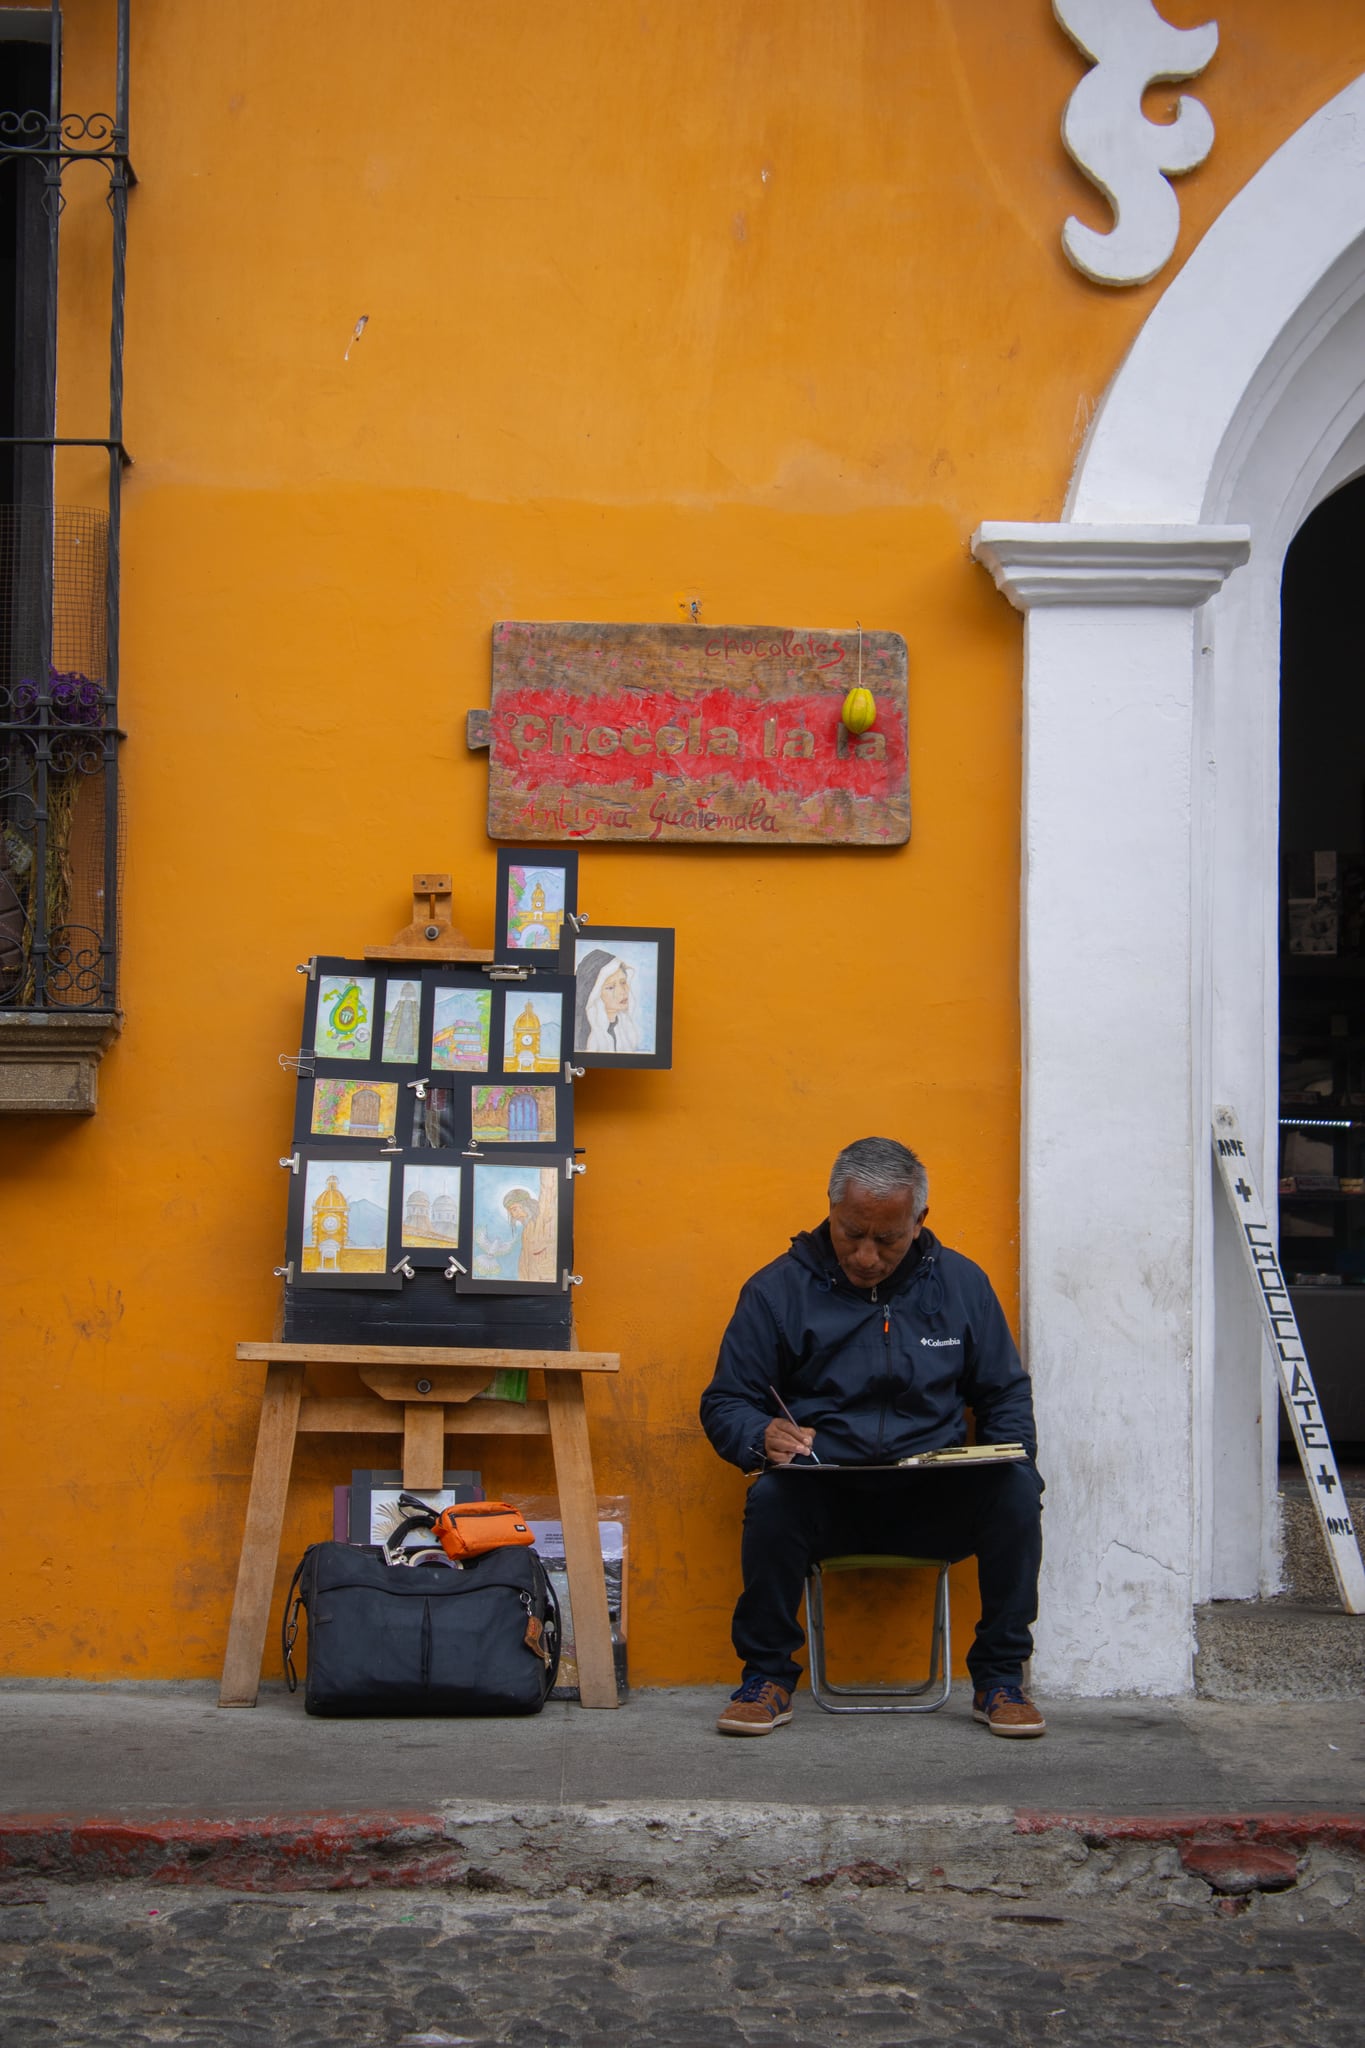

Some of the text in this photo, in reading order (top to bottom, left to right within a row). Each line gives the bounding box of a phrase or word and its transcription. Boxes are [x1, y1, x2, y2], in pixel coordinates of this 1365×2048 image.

[704, 629, 845, 669] chocolates
[503, 710, 888, 762] Chocola la la
[512, 791, 780, 841] Antigua Guatemala
[927, 1338, 961, 1347] Columbia
